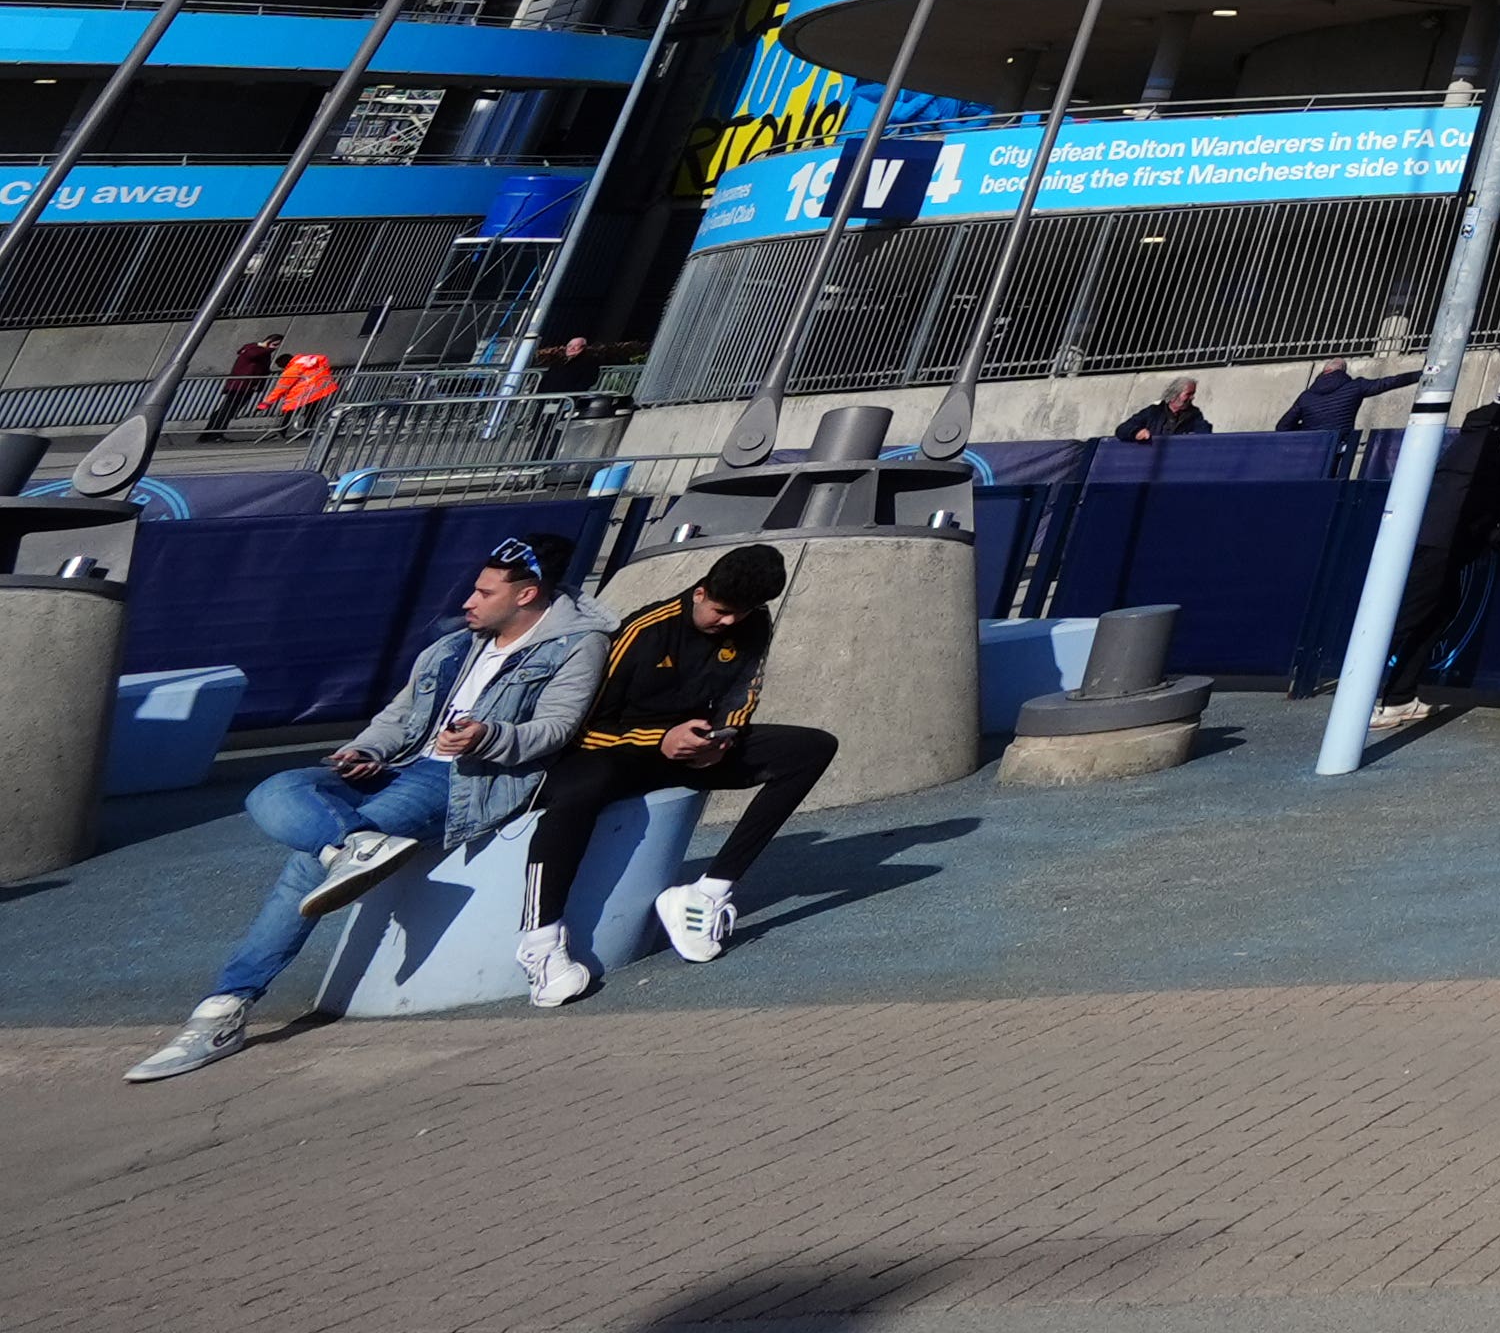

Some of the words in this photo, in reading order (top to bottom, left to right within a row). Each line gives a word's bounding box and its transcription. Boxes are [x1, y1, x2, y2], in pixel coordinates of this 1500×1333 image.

[989, 145, 1032, 168] City
[1107, 139, 1186, 160] Bolton
[1191, 134, 1325, 157] Wanderers
[1328, 132, 1352, 151] in
[1355, 131, 1397, 150] the
[1401, 129, 1435, 149] FA
[862, 159, 904, 209] V
[1090, 169, 1129, 188] the
[1133, 167, 1183, 187] first
[1188, 161, 1341, 184] Manchester
[1351, 158, 1398, 178] side
[1403, 158, 1429, 175] to
[91, 185, 202, 208] away
